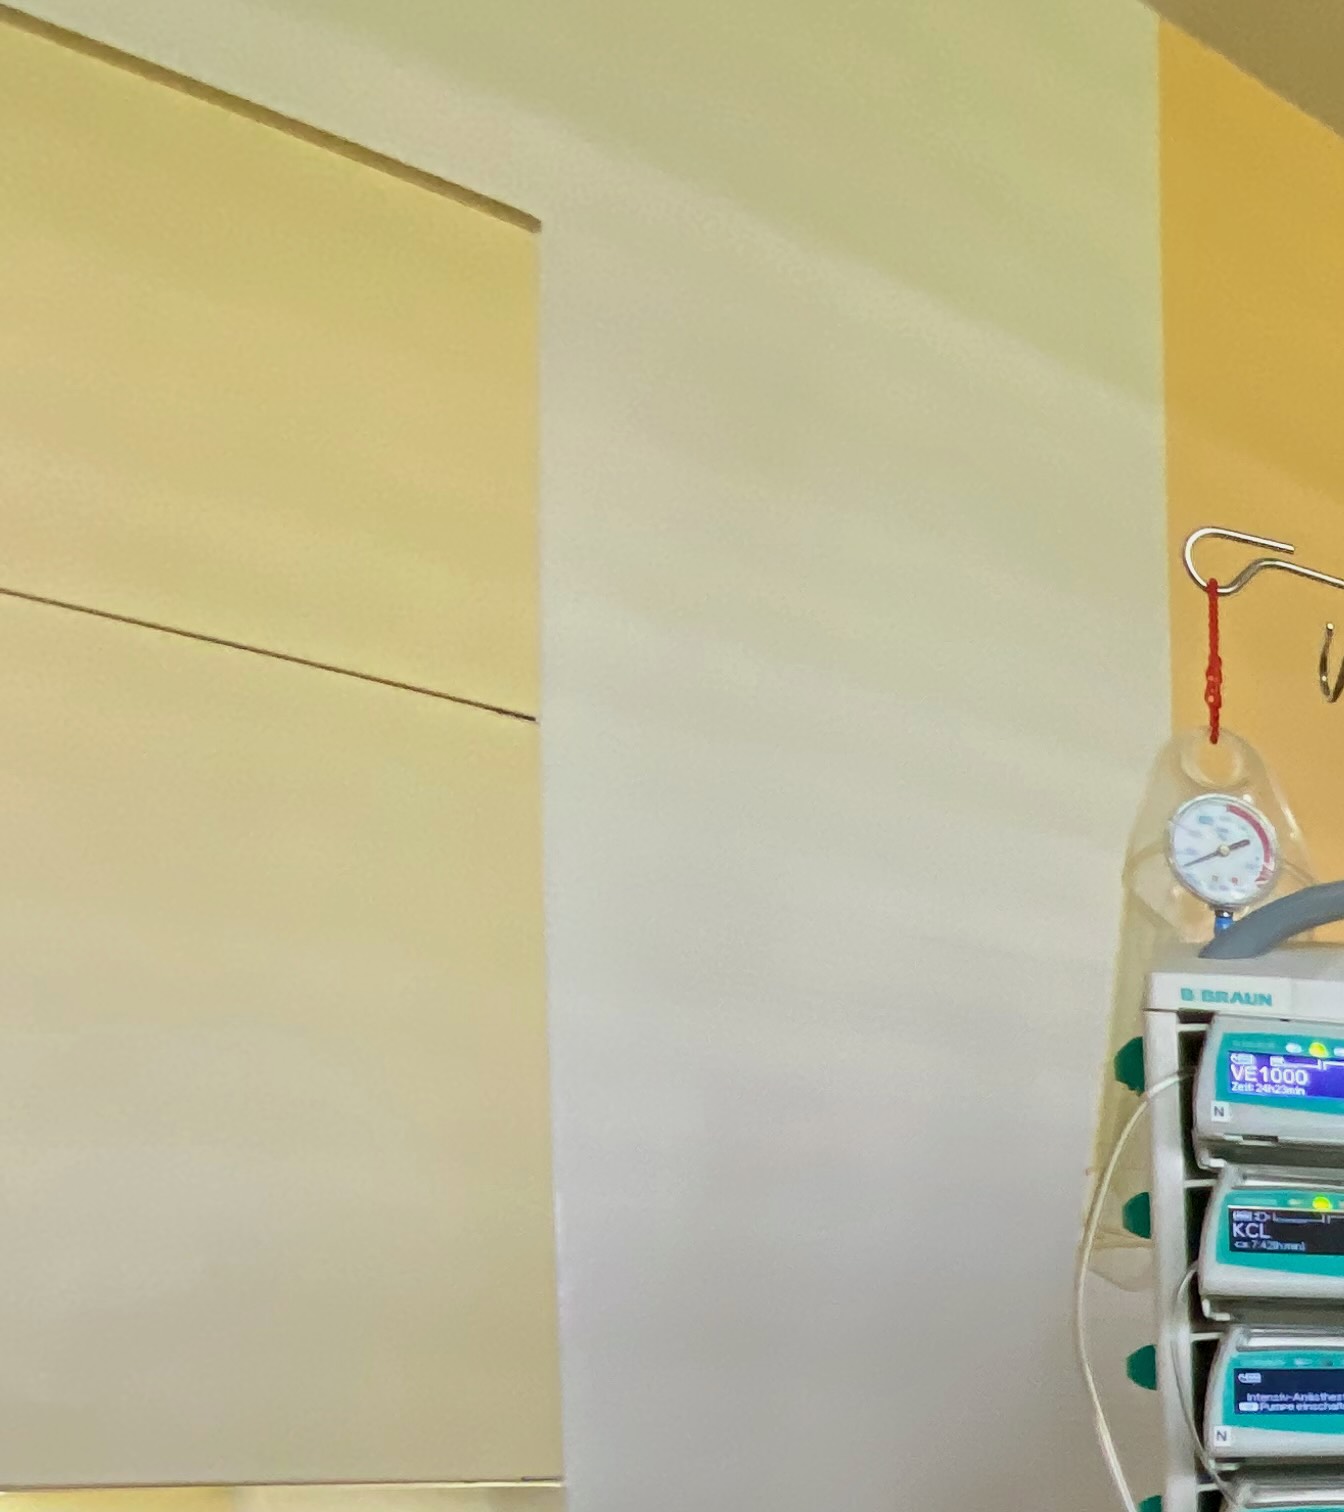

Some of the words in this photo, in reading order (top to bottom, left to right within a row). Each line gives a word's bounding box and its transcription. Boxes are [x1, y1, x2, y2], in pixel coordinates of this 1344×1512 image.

[1201, 990, 1273, 1008] BRAUN
[1214, 1105, 1225, 1117] N
[1232, 1222, 1272, 1239] KCL
[1216, 1430, 1227, 1441] N
